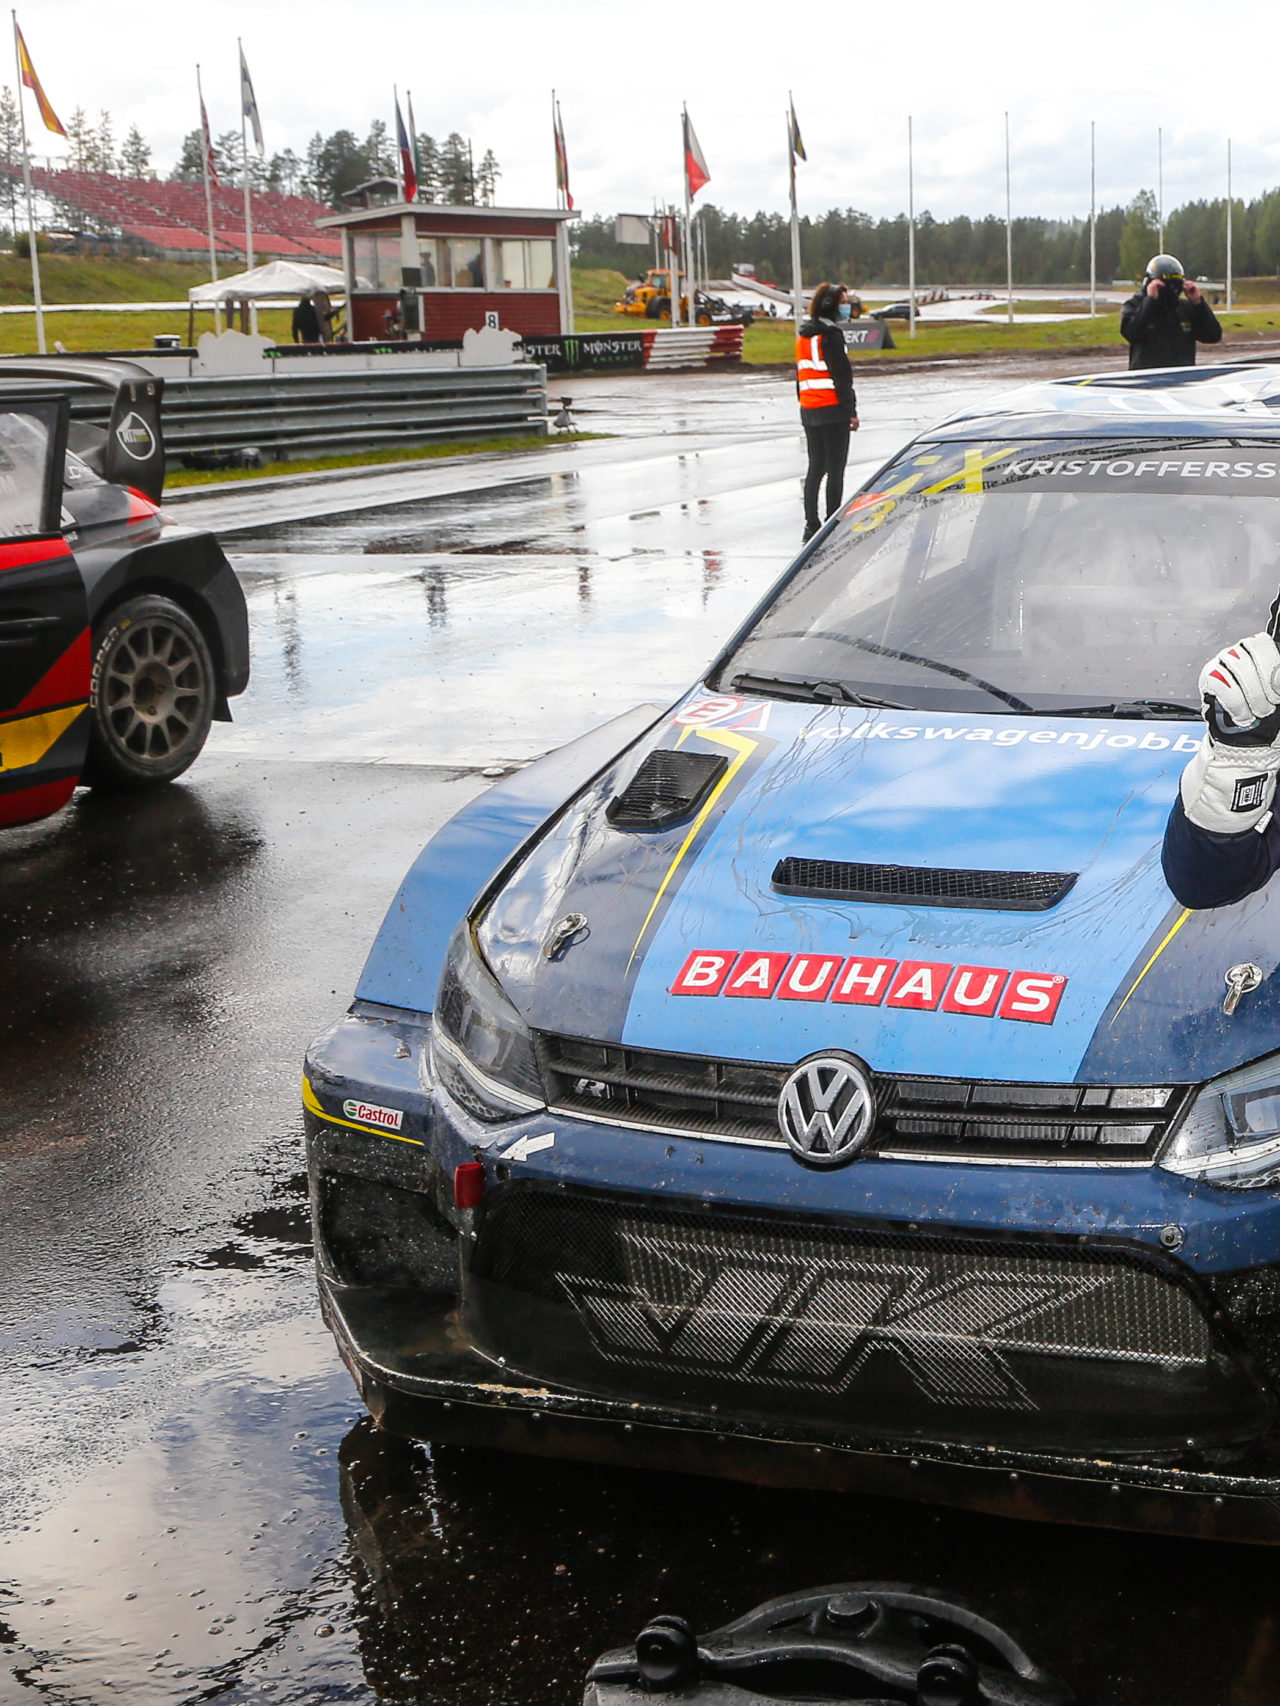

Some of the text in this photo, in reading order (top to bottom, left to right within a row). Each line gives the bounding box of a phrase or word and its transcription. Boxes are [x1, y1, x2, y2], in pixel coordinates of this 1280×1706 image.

[487, 313, 498, 329] 8
[583, 339, 642, 355] MONSTER
[852, 501, 896, 532] 3
[680, 955, 1056, 1013] BAUHAUS
[358, 1104, 400, 1127] Castrol
